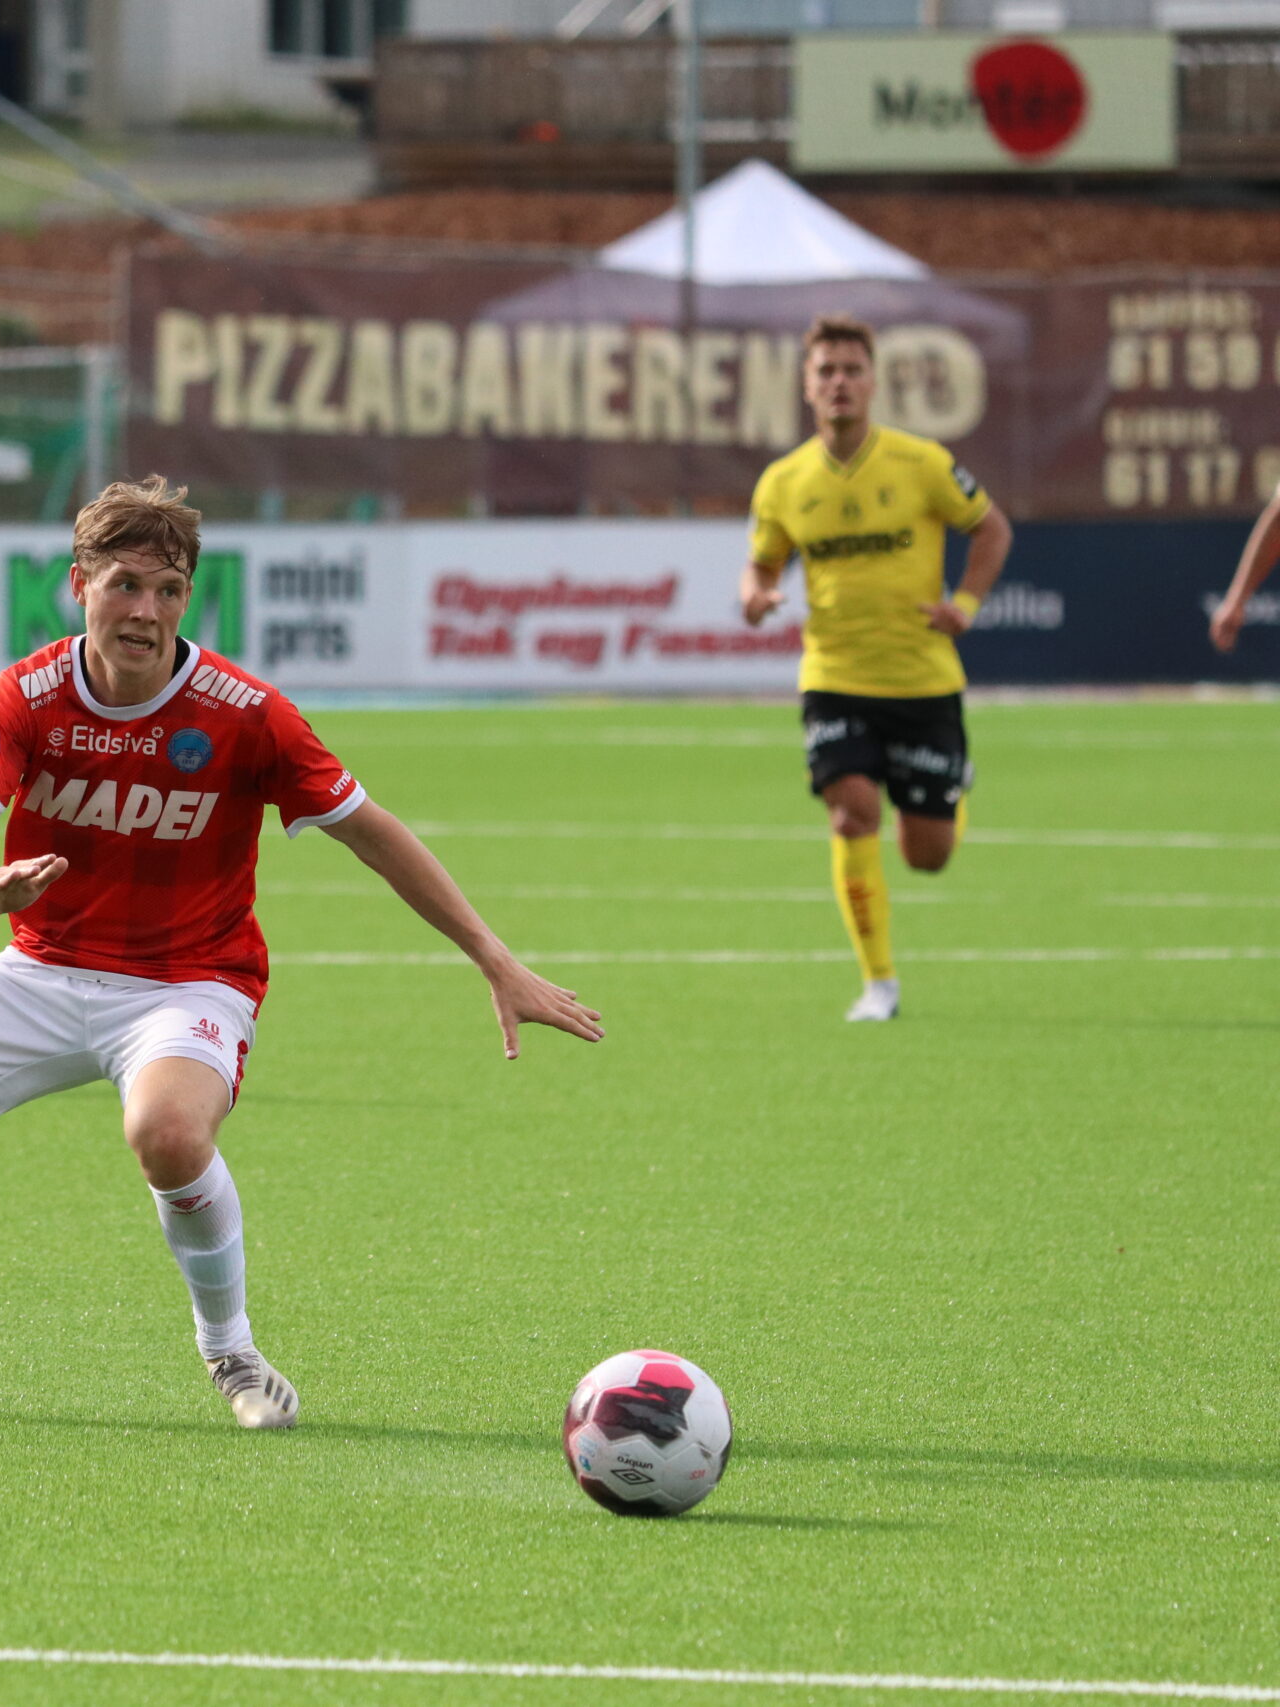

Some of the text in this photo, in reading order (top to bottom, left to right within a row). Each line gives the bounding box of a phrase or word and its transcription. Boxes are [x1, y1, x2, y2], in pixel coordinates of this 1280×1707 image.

[154, 310, 803, 449] PIZZABAKEREN
[264, 545, 365, 600] mini
[261, 615, 355, 668] pris
[71, 724, 158, 756] Eidsiva
[23, 771, 219, 840] MAPEI
[198, 1018, 220, 1035] 40
[616, 1455, 654, 1471] umbro
